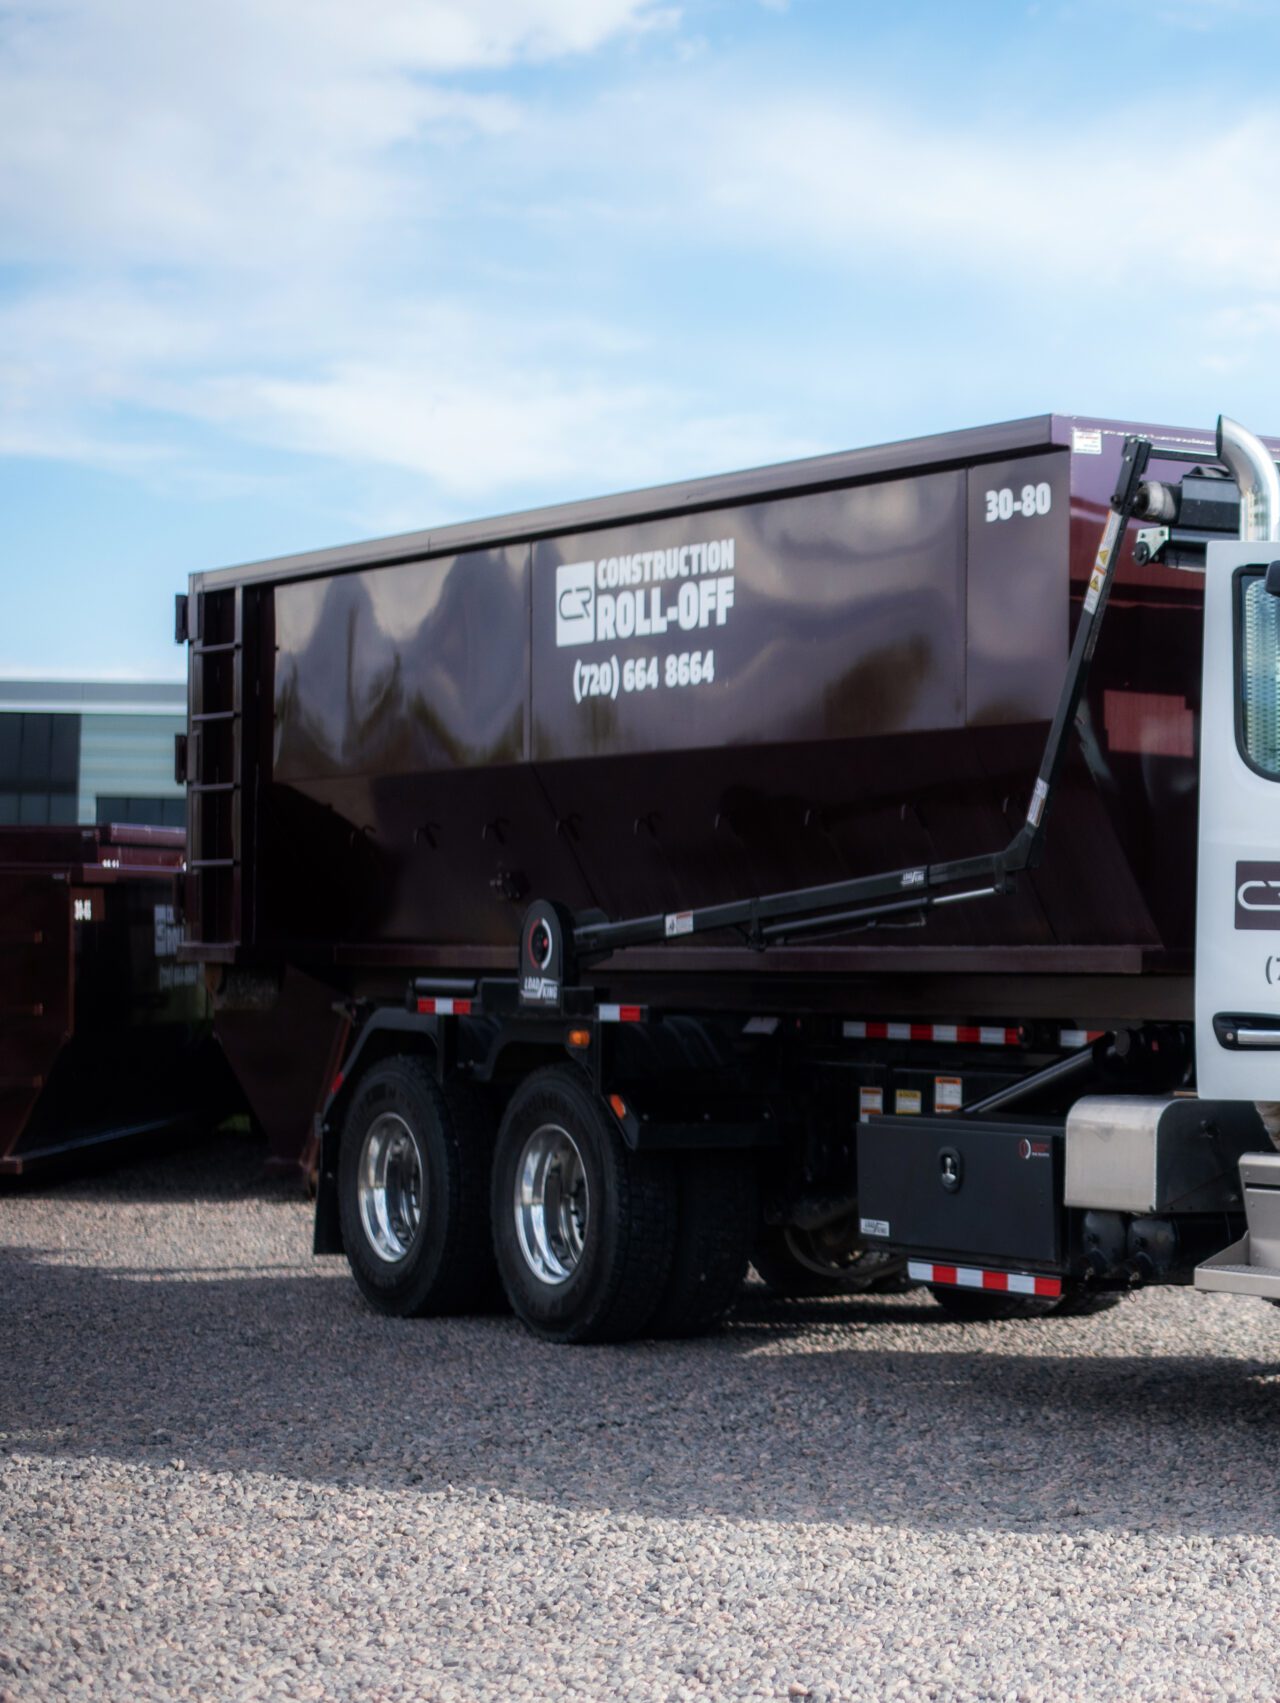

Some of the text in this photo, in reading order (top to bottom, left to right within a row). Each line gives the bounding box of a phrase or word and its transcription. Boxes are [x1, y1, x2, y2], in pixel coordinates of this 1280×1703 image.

[985, 482, 1052, 523] 30-80
[597, 538, 735, 588] CONSTRUCTION
[596, 575, 735, 642] ROLL-OFF
[572, 649, 715, 704] (720) 664 8664
